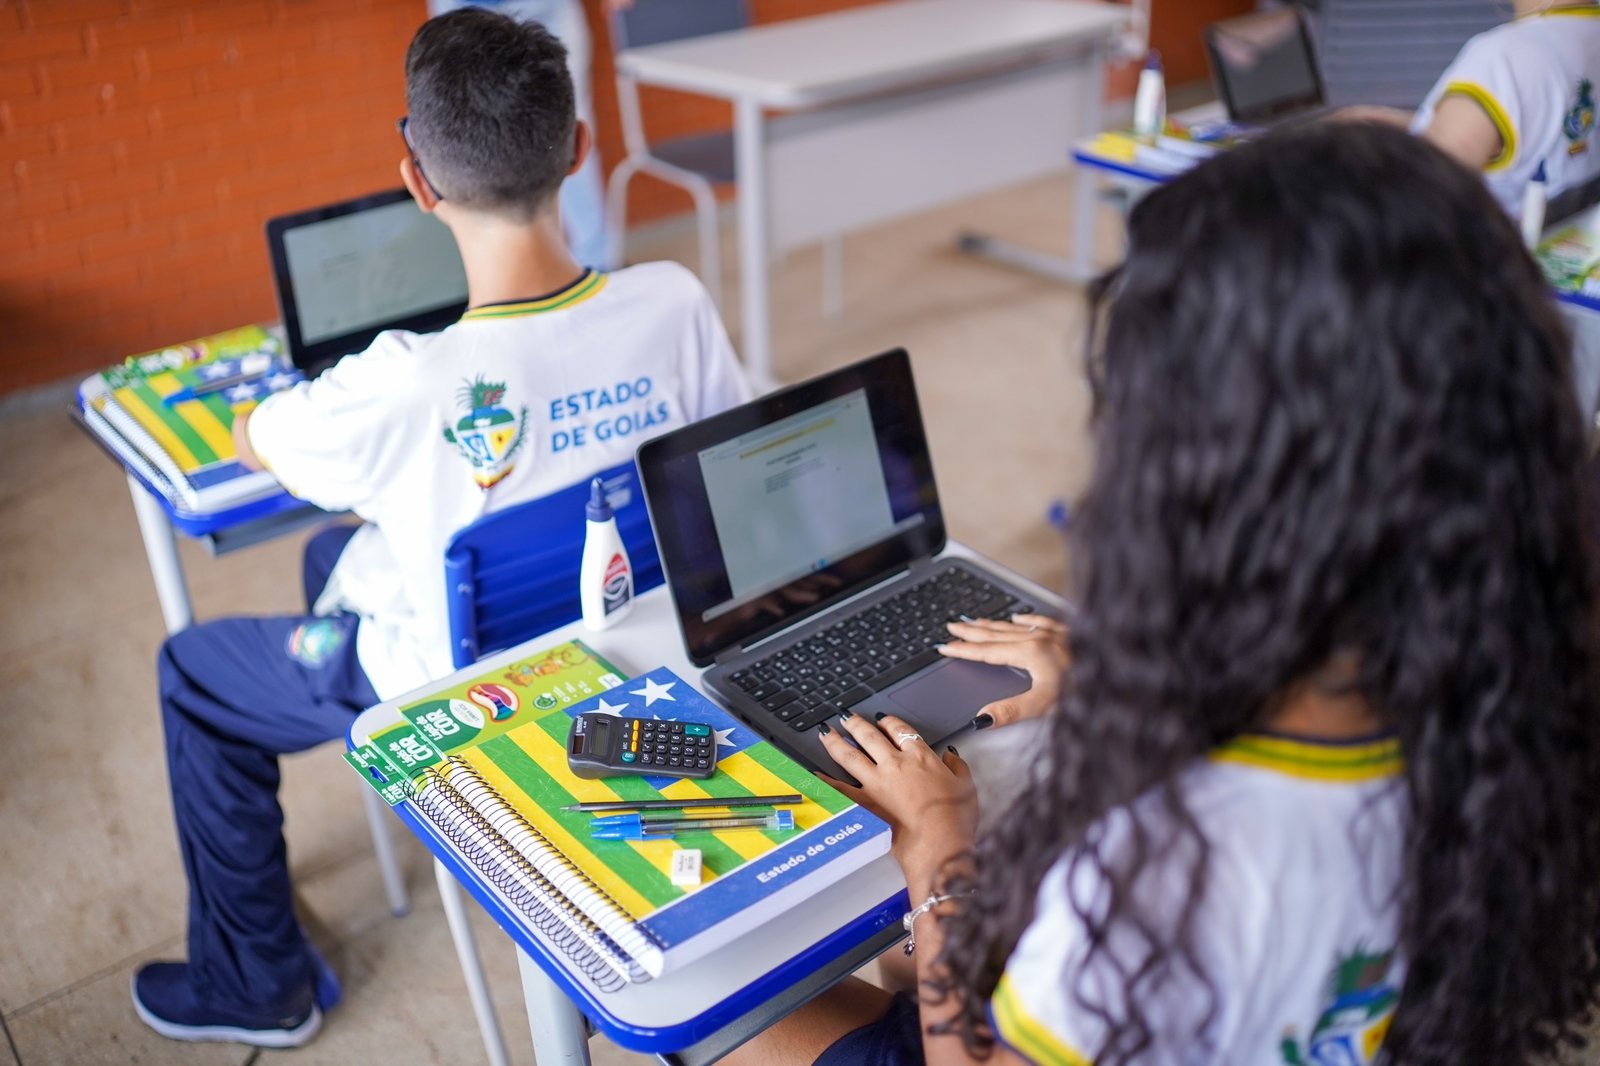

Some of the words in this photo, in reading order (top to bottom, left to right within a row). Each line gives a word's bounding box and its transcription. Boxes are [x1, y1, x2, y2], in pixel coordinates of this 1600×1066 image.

[550, 377, 653, 421] ESTADO
[552, 428, 587, 453] DE
[594, 401, 670, 441] GOIÁS
[416, 715, 429, 726] de
[423, 722, 443, 740] Lápis
[425, 708, 461, 735] COR
[388, 741, 401, 752] de
[396, 748, 417, 767] Lápis
[398, 733, 434, 760] COR
[387, 783, 406, 800] COR
[756, 853, 807, 884] Estado
[806, 842, 826, 857] de
[823, 822, 864, 846] Goiás
